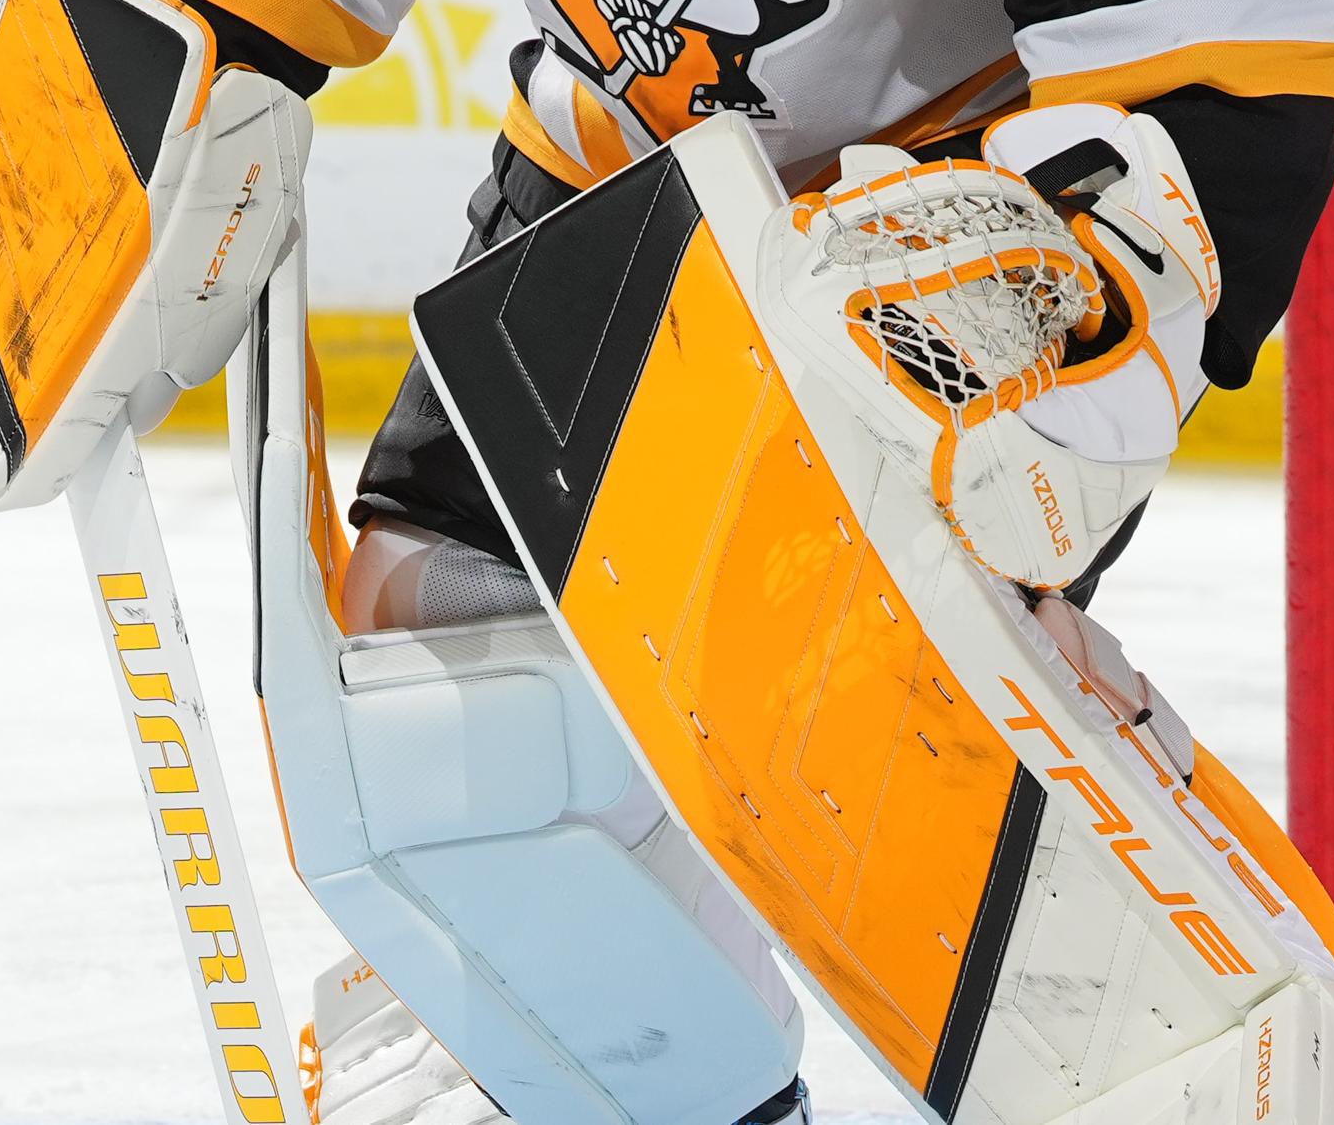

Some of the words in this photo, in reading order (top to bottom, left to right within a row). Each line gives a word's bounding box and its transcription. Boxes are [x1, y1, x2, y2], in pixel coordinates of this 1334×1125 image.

[197, 163, 260, 302] HZRDUS
[1160, 172, 1219, 320] TRUE
[1027, 460, 1073, 558] HZRDUS
[97, 572, 287, 1125] WARRIO
[997, 674, 1257, 977] TRUE
[1256, 1016, 1273, 1121] HZRDUS
